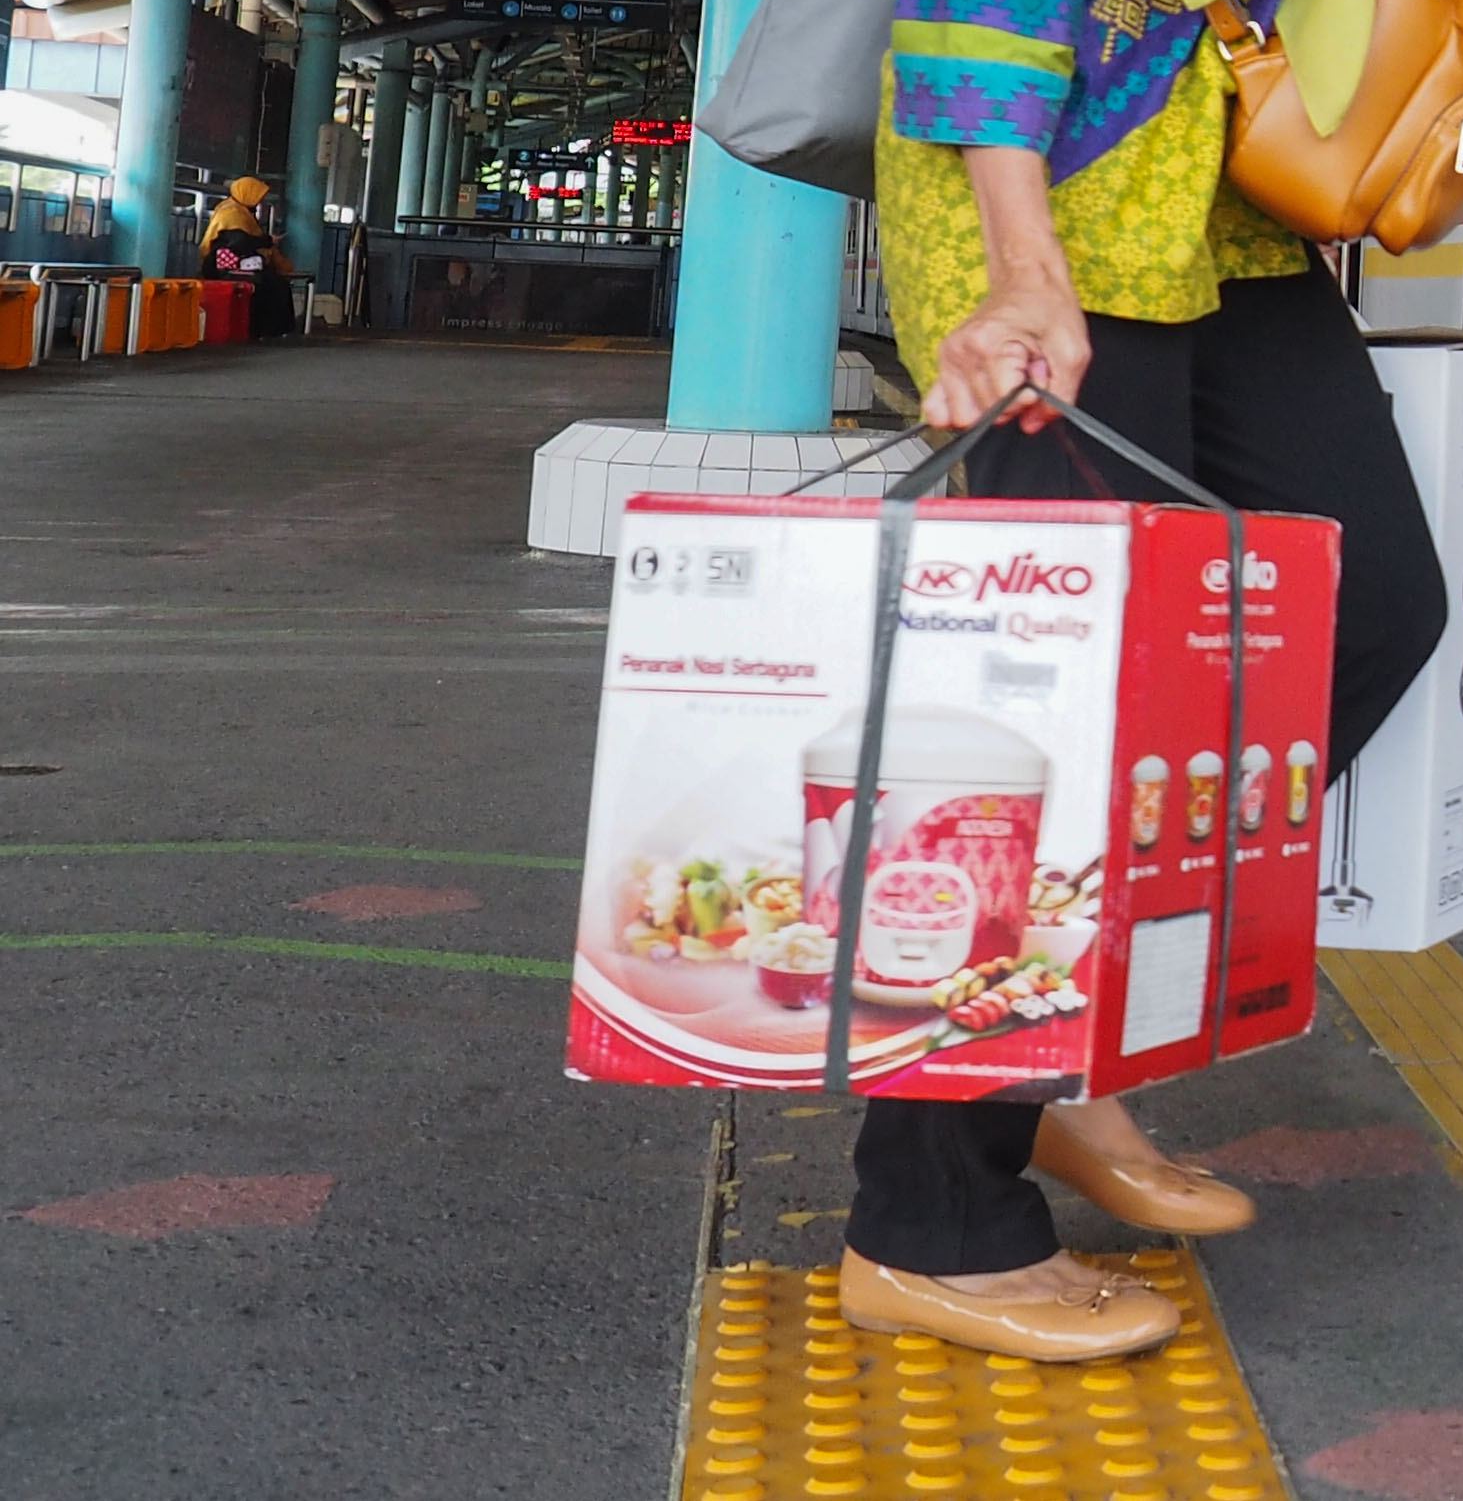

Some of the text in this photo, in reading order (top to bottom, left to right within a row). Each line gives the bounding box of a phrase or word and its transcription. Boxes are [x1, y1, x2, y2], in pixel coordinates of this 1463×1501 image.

[520, 151, 528, 161] 2
[1007, 612, 1092, 642] Quality
[621, 653, 817, 683] Penanak Nasi Serbaguna
